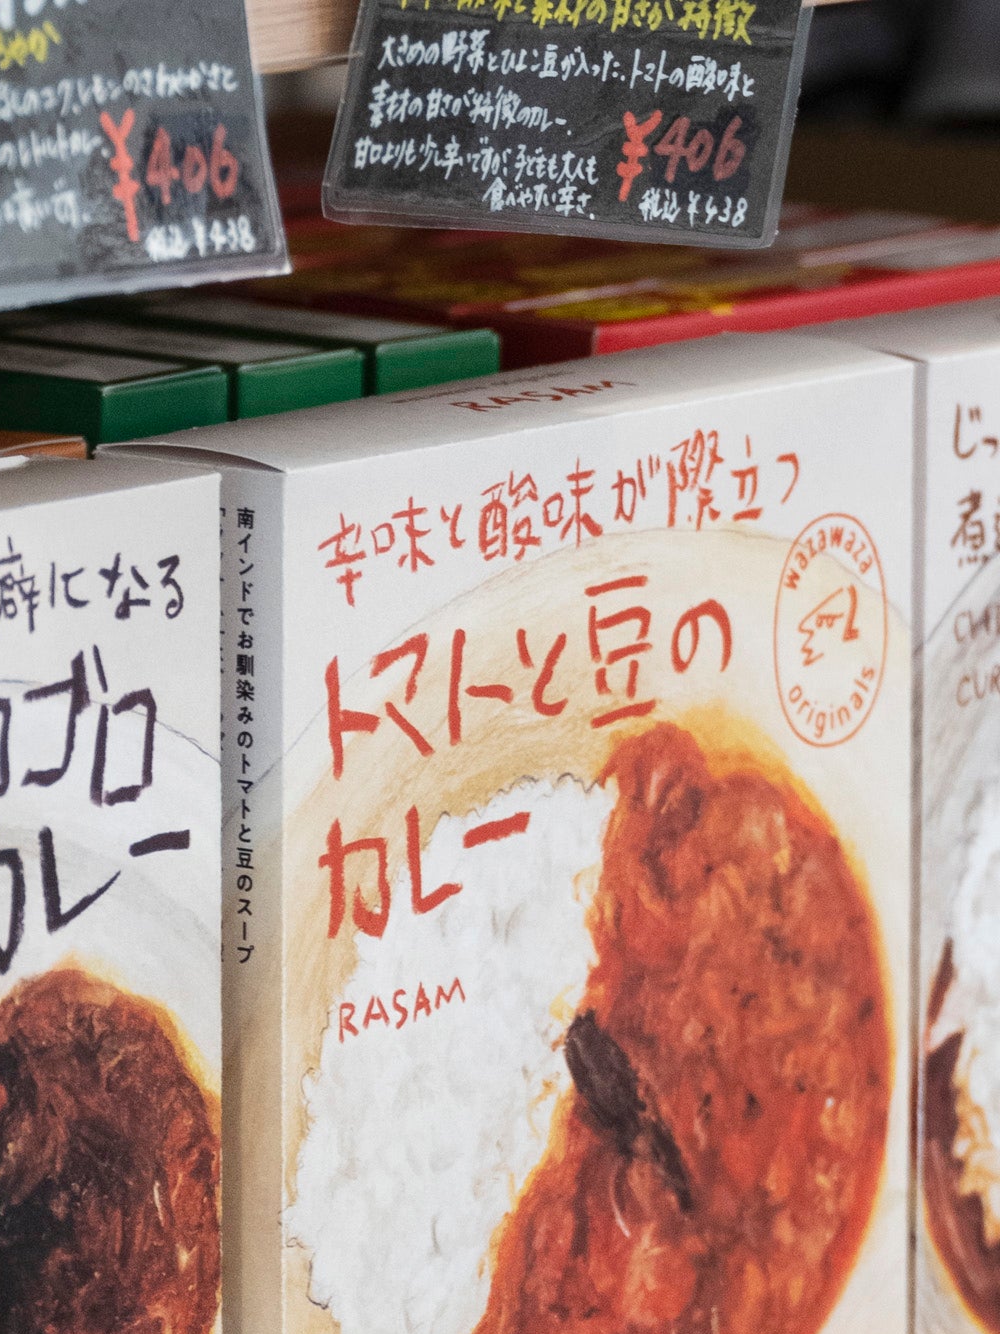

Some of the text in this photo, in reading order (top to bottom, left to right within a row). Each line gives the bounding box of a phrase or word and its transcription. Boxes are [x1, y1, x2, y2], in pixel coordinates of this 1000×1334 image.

[99, 108, 239, 243] ¥406
[616, 109, 747, 202] ¥406
[317, 429, 801, 607] 辛味と酸味が際立つ
[783, 525, 874, 591] wazawaza
[951, 488, 1000, 567] 煮
[325, 574, 734, 780] トマトと豆の
[788, 665, 876, 739] originals
[235, 507, 256, 965] 南インドでお馴染みのトマトと豆のスープ
[318, 807, 531, 939] カレー
[337, 977, 467, 1043] RASAM
